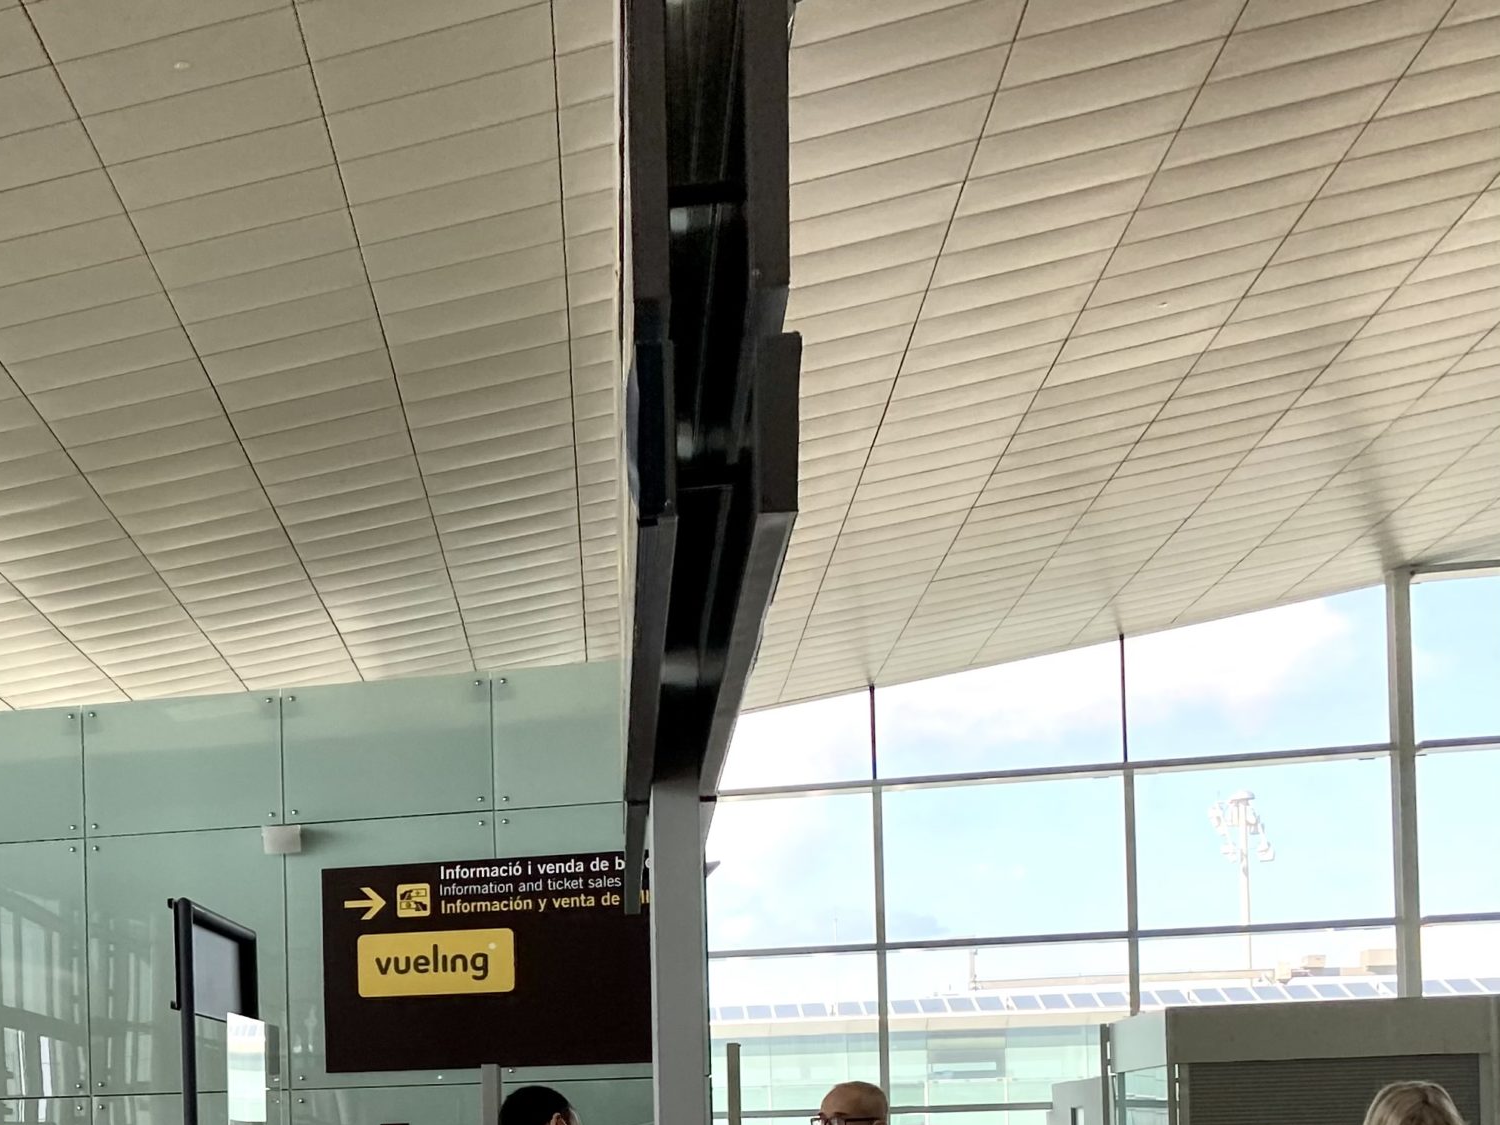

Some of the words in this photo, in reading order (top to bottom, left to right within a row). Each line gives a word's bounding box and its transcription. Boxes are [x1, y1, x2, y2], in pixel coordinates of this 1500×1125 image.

[440, 861, 522, 880] Informació
[527, 861, 532, 875] i
[537, 859, 584, 874] venda
[589, 857, 609, 872] de
[439, 881, 514, 896] Information
[518, 879, 543, 892] and
[548, 876, 584, 891] ticket
[588, 876, 622, 889] sales
[441, 896, 532, 914] Información
[538, 898, 547, 912] y
[552, 894, 595, 908] venta
[601, 892, 620, 906] de
[375, 943, 488, 980] vueling
